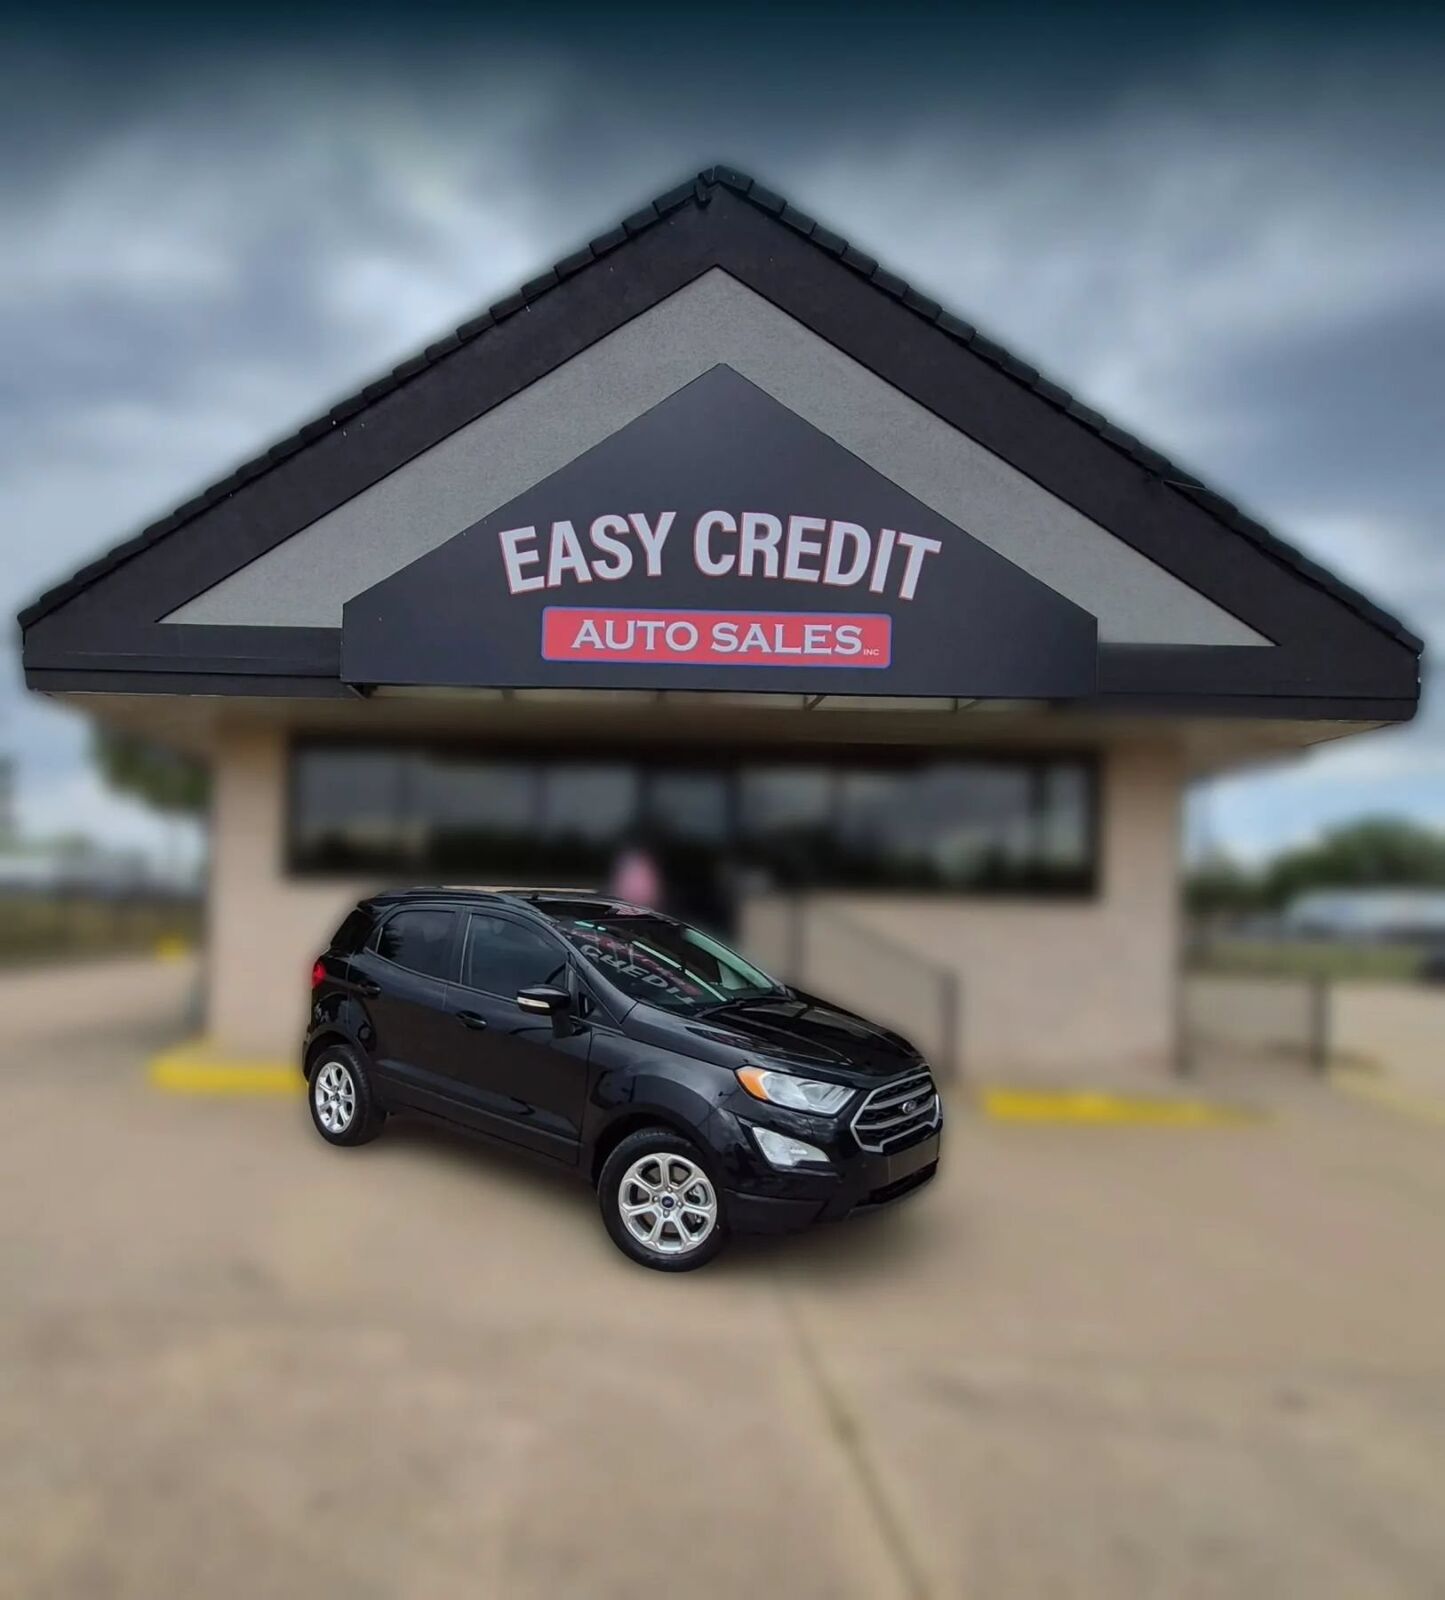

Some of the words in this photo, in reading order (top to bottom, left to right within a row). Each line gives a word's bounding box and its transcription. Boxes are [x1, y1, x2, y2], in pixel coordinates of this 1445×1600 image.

[499, 511, 676, 595] EASY
[694, 510, 942, 600] CREDIT
[571, 619, 698, 652] AUTO
[710, 622, 863, 655] SALES
[863, 648, 880, 656] INC
